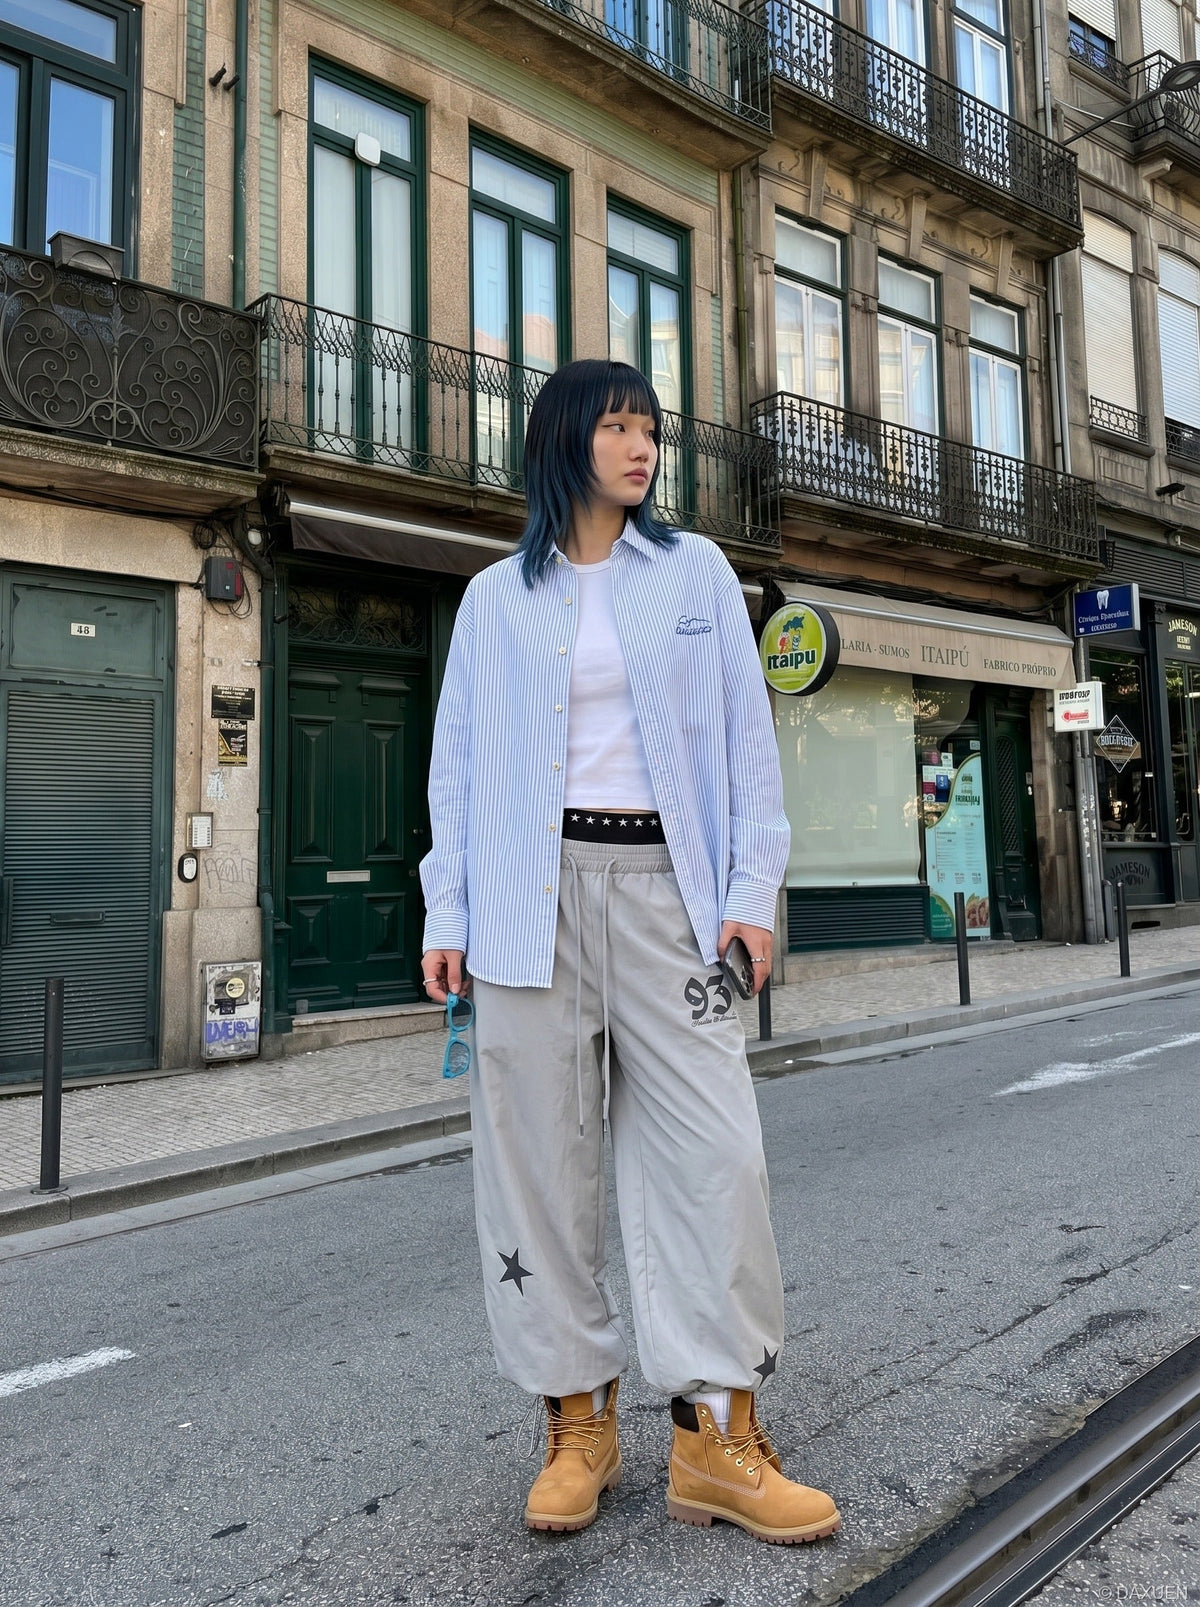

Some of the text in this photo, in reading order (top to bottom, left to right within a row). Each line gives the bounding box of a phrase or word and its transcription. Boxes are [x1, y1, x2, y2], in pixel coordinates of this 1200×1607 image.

[77, 625, 90, 635] 48
[879, 644, 910, 659] SUMOS
[920, 644, 970, 668] ITAIPÚ
[983, 658, 1020, 673] FABRICO
[1022, 662, 1057, 677] PRÓPRIO
[1110, 861, 1151, 880] JAMESON
[684, 974, 732, 1020] 93
